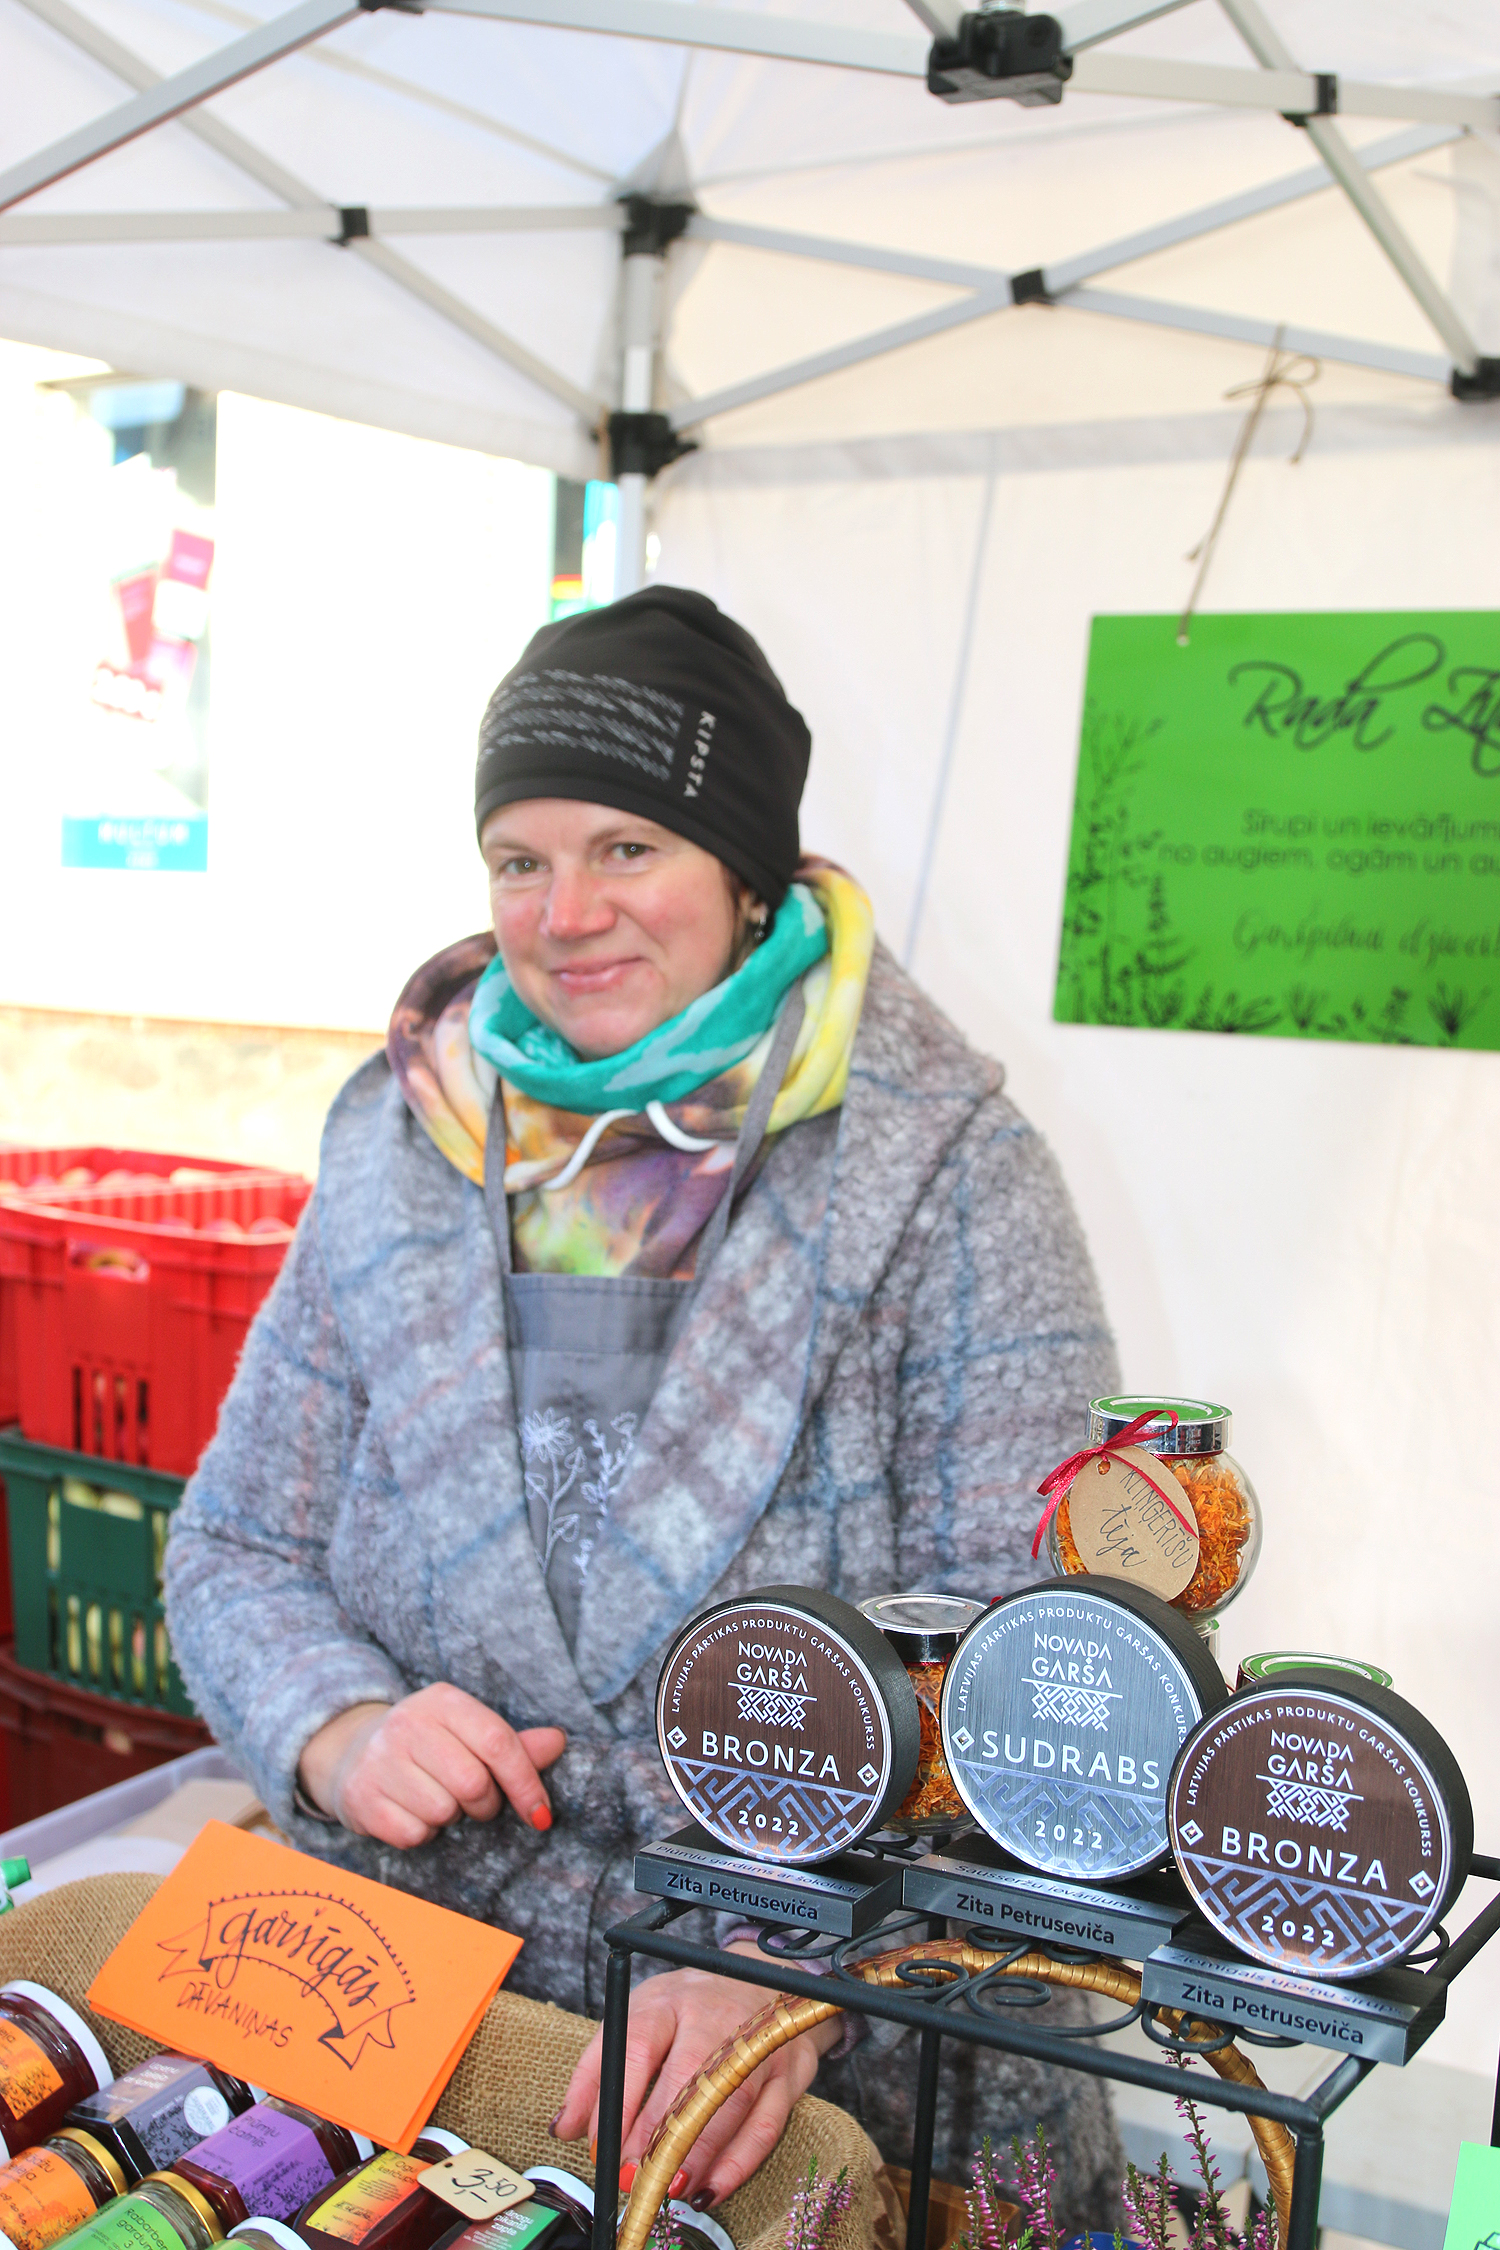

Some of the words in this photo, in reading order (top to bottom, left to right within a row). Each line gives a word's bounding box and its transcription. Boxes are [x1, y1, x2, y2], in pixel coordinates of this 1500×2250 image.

[1227, 632, 1446, 752] Rada
[683, 711, 716, 797] KIPSTA
[1241, 807, 1318, 840] Sirupi
[1322, 812, 1361, 839] un
[1158, 844, 1197, 867] no
[1422, 851, 1462, 874] un
[738, 1640, 808, 1667] NOVADA
[1034, 1632, 1113, 1661] NOVADA
[671, 1658, 694, 1713] LATVIJAS
[691, 1621, 739, 1659] PĀRTIKAS
[742, 1618, 808, 1639] PRODUKTU
[810, 1635, 851, 1678] GARŠAS
[848, 1678, 875, 1750] KONKURSS
[736, 1663, 809, 1693] GARŠA
[957, 1652, 983, 1712] LATVIJAS
[981, 1611, 1035, 1653] PĀRTIKAS
[1039, 1607, 1113, 1630] PRODUKTU
[1116, 1627, 1162, 1672] GARŠAS
[1159, 1673, 1188, 1748] KONKURS
[1032, 1656, 1113, 1689] GARŠA
[702, 1730, 840, 1782] BRONZA
[981, 1730, 1160, 1790] SUDRABS
[1270, 1729, 1354, 1763] NOVADA
[1187, 1747, 1215, 1806] LATVIJAS
[1213, 1708, 1272, 1748] PĀRTIKAS
[1277, 1706, 1355, 1730] PRODUKTU
[1358, 1728, 1406, 1775] GARŠAS
[1402, 1777, 1432, 1858] KONKURSS
[1267, 1754, 1354, 1791] GARŠA
[738, 1810, 799, 1836] 2022
[1034, 1820, 1103, 1849] 2022
[710, 1857, 773, 1876] gardums
[777, 1873, 794, 1881] ar
[1221, 1826, 1387, 1890] BRONZA
[667, 1872, 703, 1894] Zita
[709, 1881, 818, 1921] Petruseviča
[1048, 1881, 1143, 1912] ievārījums
[956, 1893, 994, 1917] Zita
[1000, 1903, 1115, 1945] Petruseviča
[1261, 1915, 1335, 1948] 2022
[1270, 1976, 1337, 2000] upeņu
[1181, 1982, 1225, 2009] Zita
[1232, 1994, 1364, 2045] Petruseviča
[241, 2114, 281, 2138] Plūmju
